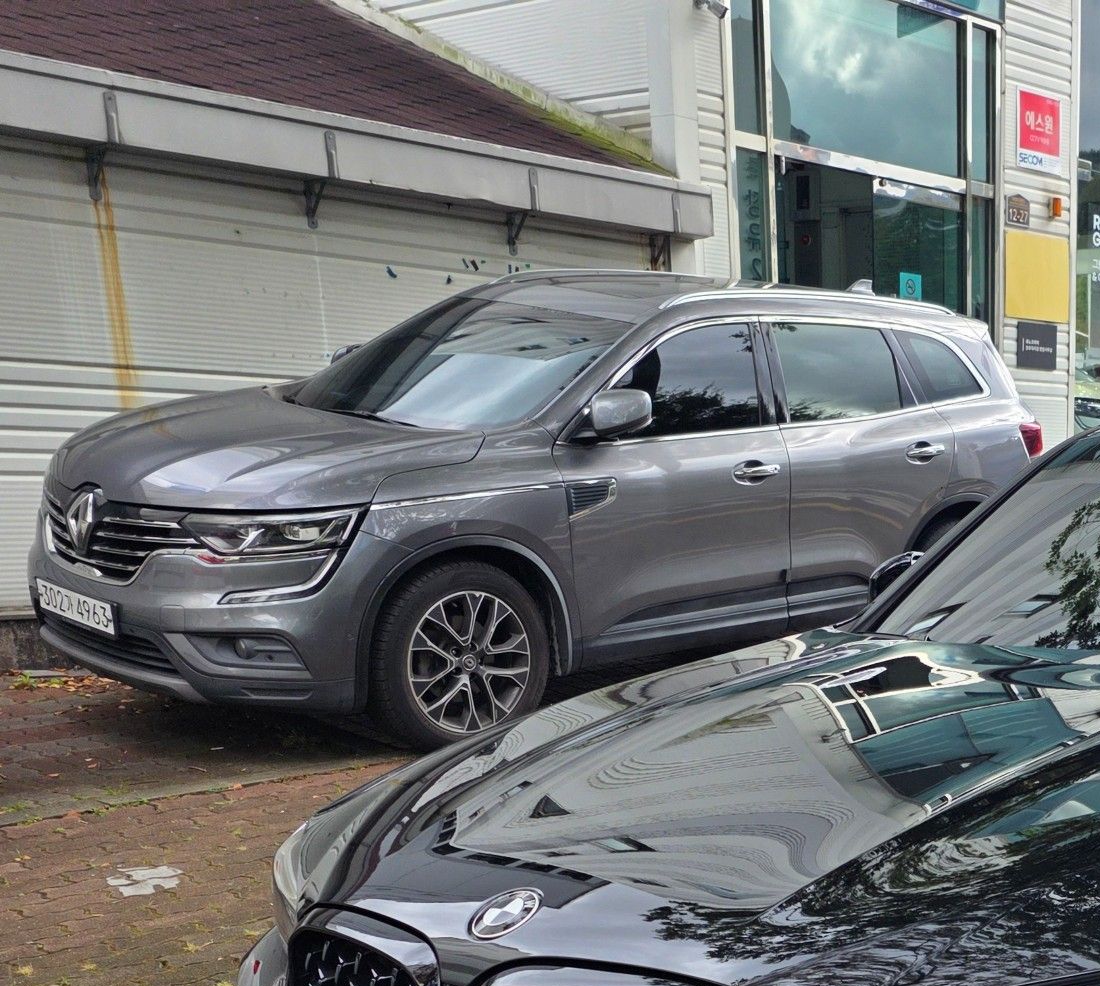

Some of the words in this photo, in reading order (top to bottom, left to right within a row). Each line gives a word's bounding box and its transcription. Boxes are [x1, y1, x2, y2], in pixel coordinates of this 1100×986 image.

[1025, 110, 1054, 135] 에스원
[1019, 152, 1043, 166] SECOM
[1008, 208, 1029, 224] 12-27
[76, 597, 110, 628] 4963
